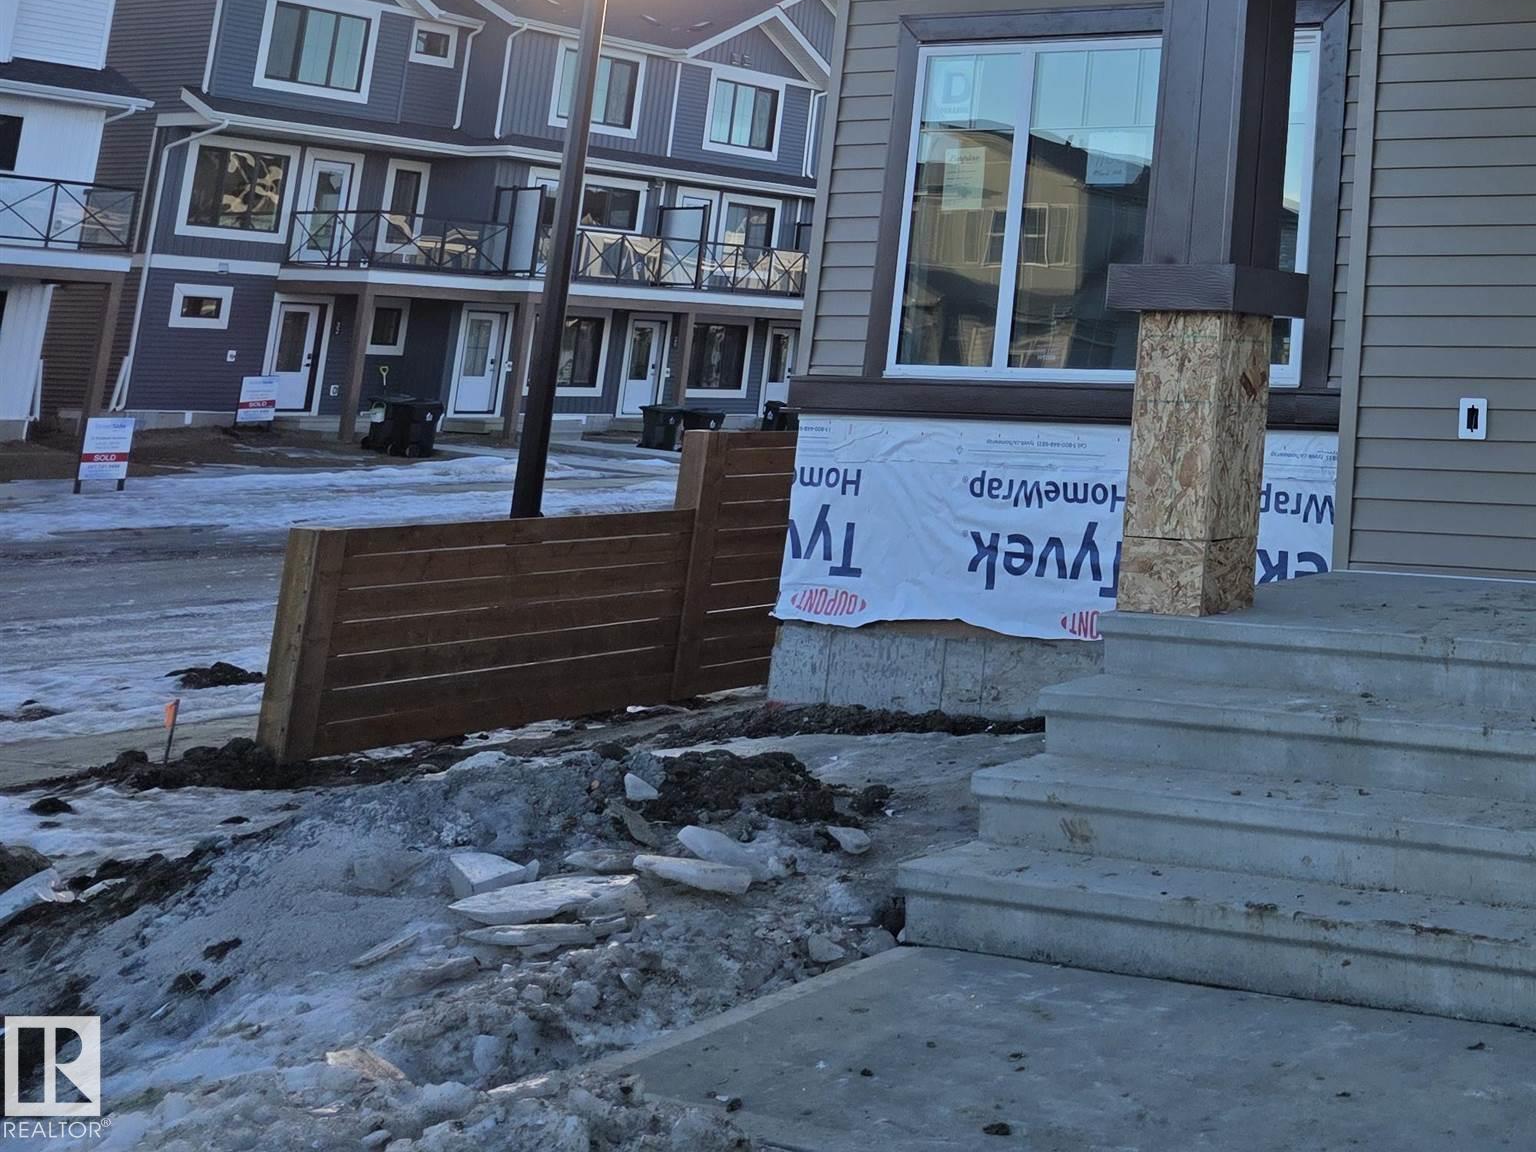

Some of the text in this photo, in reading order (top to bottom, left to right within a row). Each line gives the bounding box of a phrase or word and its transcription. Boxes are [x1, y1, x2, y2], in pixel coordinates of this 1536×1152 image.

[93, 454, 117, 462] SOLD
[791, 466, 862, 497] Hom
[797, 586, 859, 617] DUPONT
